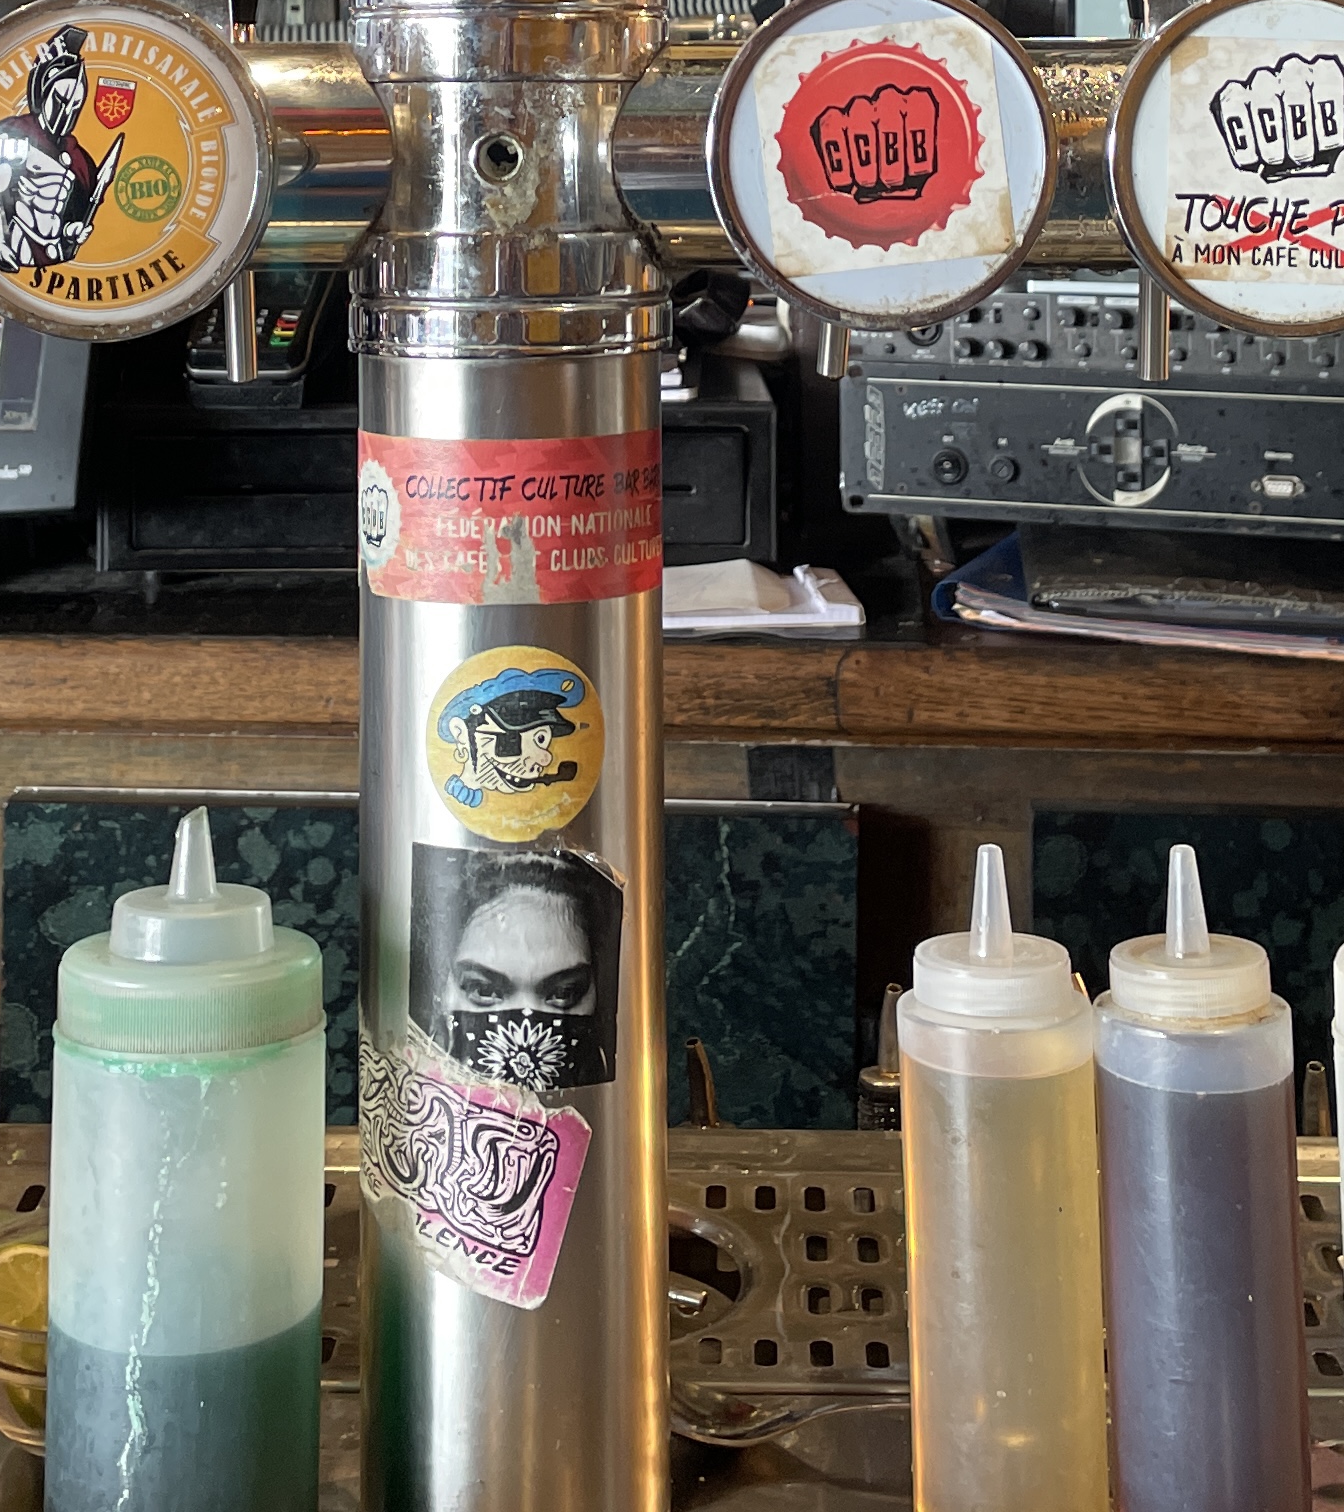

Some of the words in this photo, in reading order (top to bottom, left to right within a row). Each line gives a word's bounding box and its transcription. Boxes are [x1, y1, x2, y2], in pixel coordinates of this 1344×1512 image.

[84, 31, 225, 124] ARTISANALE
[190, 139, 219, 221] BLONDE
[1226, 99, 1339, 150] CCBB
[825, 128, 928, 173] CCBB
[129, 178, 169, 200] BIO
[1175, 193, 1310, 235] TOUCHE
[1172, 234, 1184, 264] À
[1194, 243, 1242, 267] MON
[1251, 242, 1298, 268] CAFÉ
[29, 249, 187, 302] SPARTIATE
[406, 474, 515, 501] COLLECTIF
[521, 473, 605, 502] CULTURE
[571, 504, 653, 537] NATIONALE
